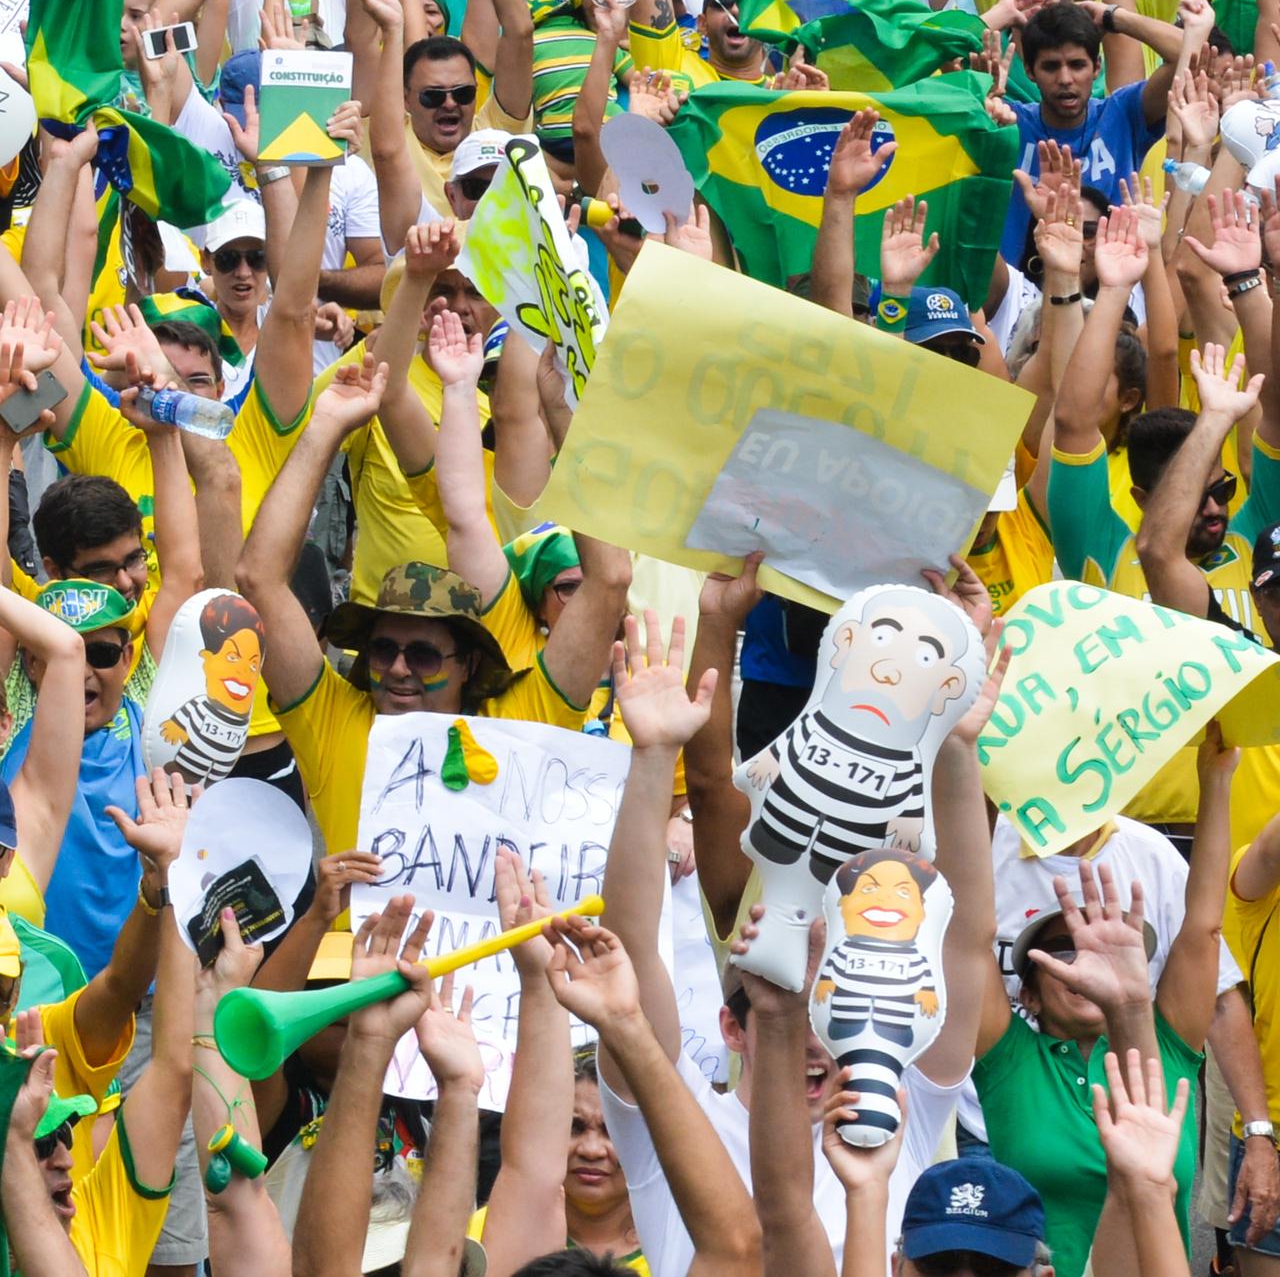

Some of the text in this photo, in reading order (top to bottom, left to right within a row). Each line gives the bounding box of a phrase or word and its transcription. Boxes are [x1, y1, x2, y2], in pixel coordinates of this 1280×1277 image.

[268, 70, 344, 86] CONSTITUIÇÃO
[1006, 577, 1108, 656] OVO
[1074, 616, 1146, 677] EM
[368, 736, 626, 830] A NOSS
[945, 1207, 989, 1219] BELGIUM
